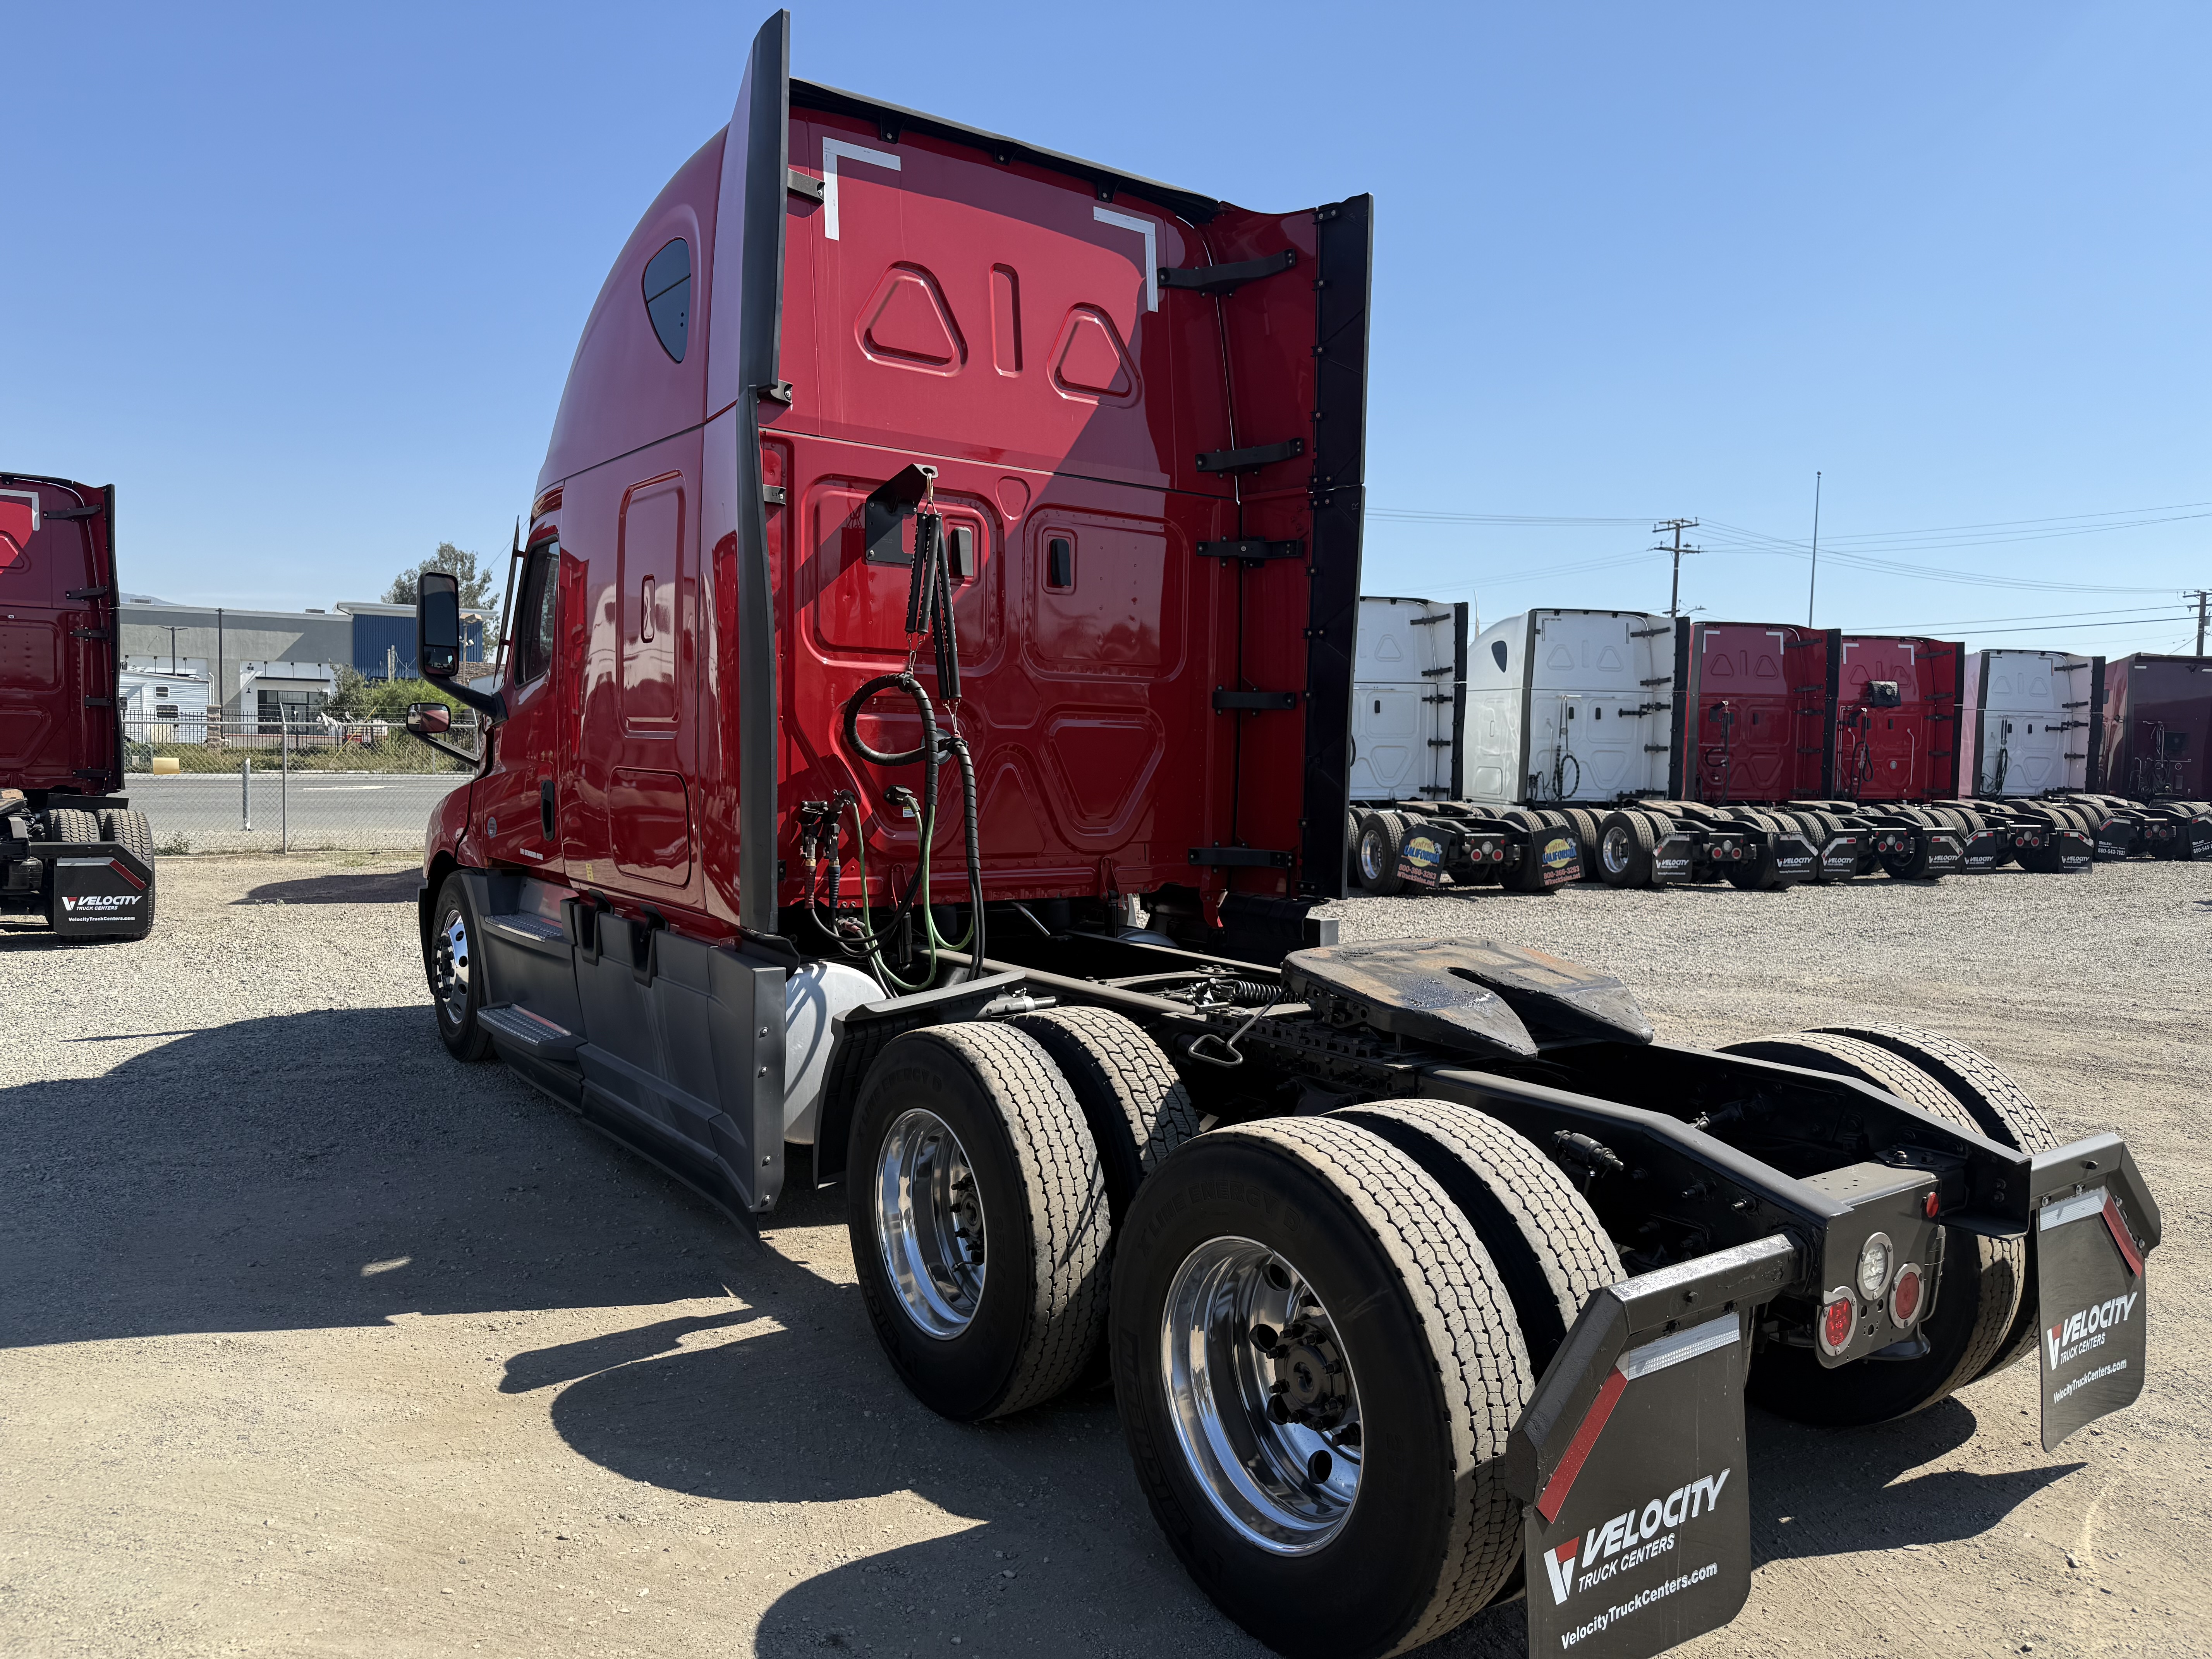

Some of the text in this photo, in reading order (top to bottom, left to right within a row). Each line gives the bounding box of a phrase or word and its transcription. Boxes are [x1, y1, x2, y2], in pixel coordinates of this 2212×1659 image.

[1404, 845, 1440, 864] CALIFORNIA
[1542, 846, 1577, 864] CALIFORNIA
[78, 895, 142, 905] VELOCITY
[2062, 1291, 2138, 1346] VELOCITY
[2060, 1332, 2106, 1365] TRUCK CENTERS
[2054, 1359, 2127, 1404] VelocityTruckCenters.com
[1582, 1468, 1730, 1568] VELOCITY
[1578, 1532, 1675, 1593] TRUCK CENTERS
[1561, 1562, 1718, 1650] VelocityTruckCenters.com
